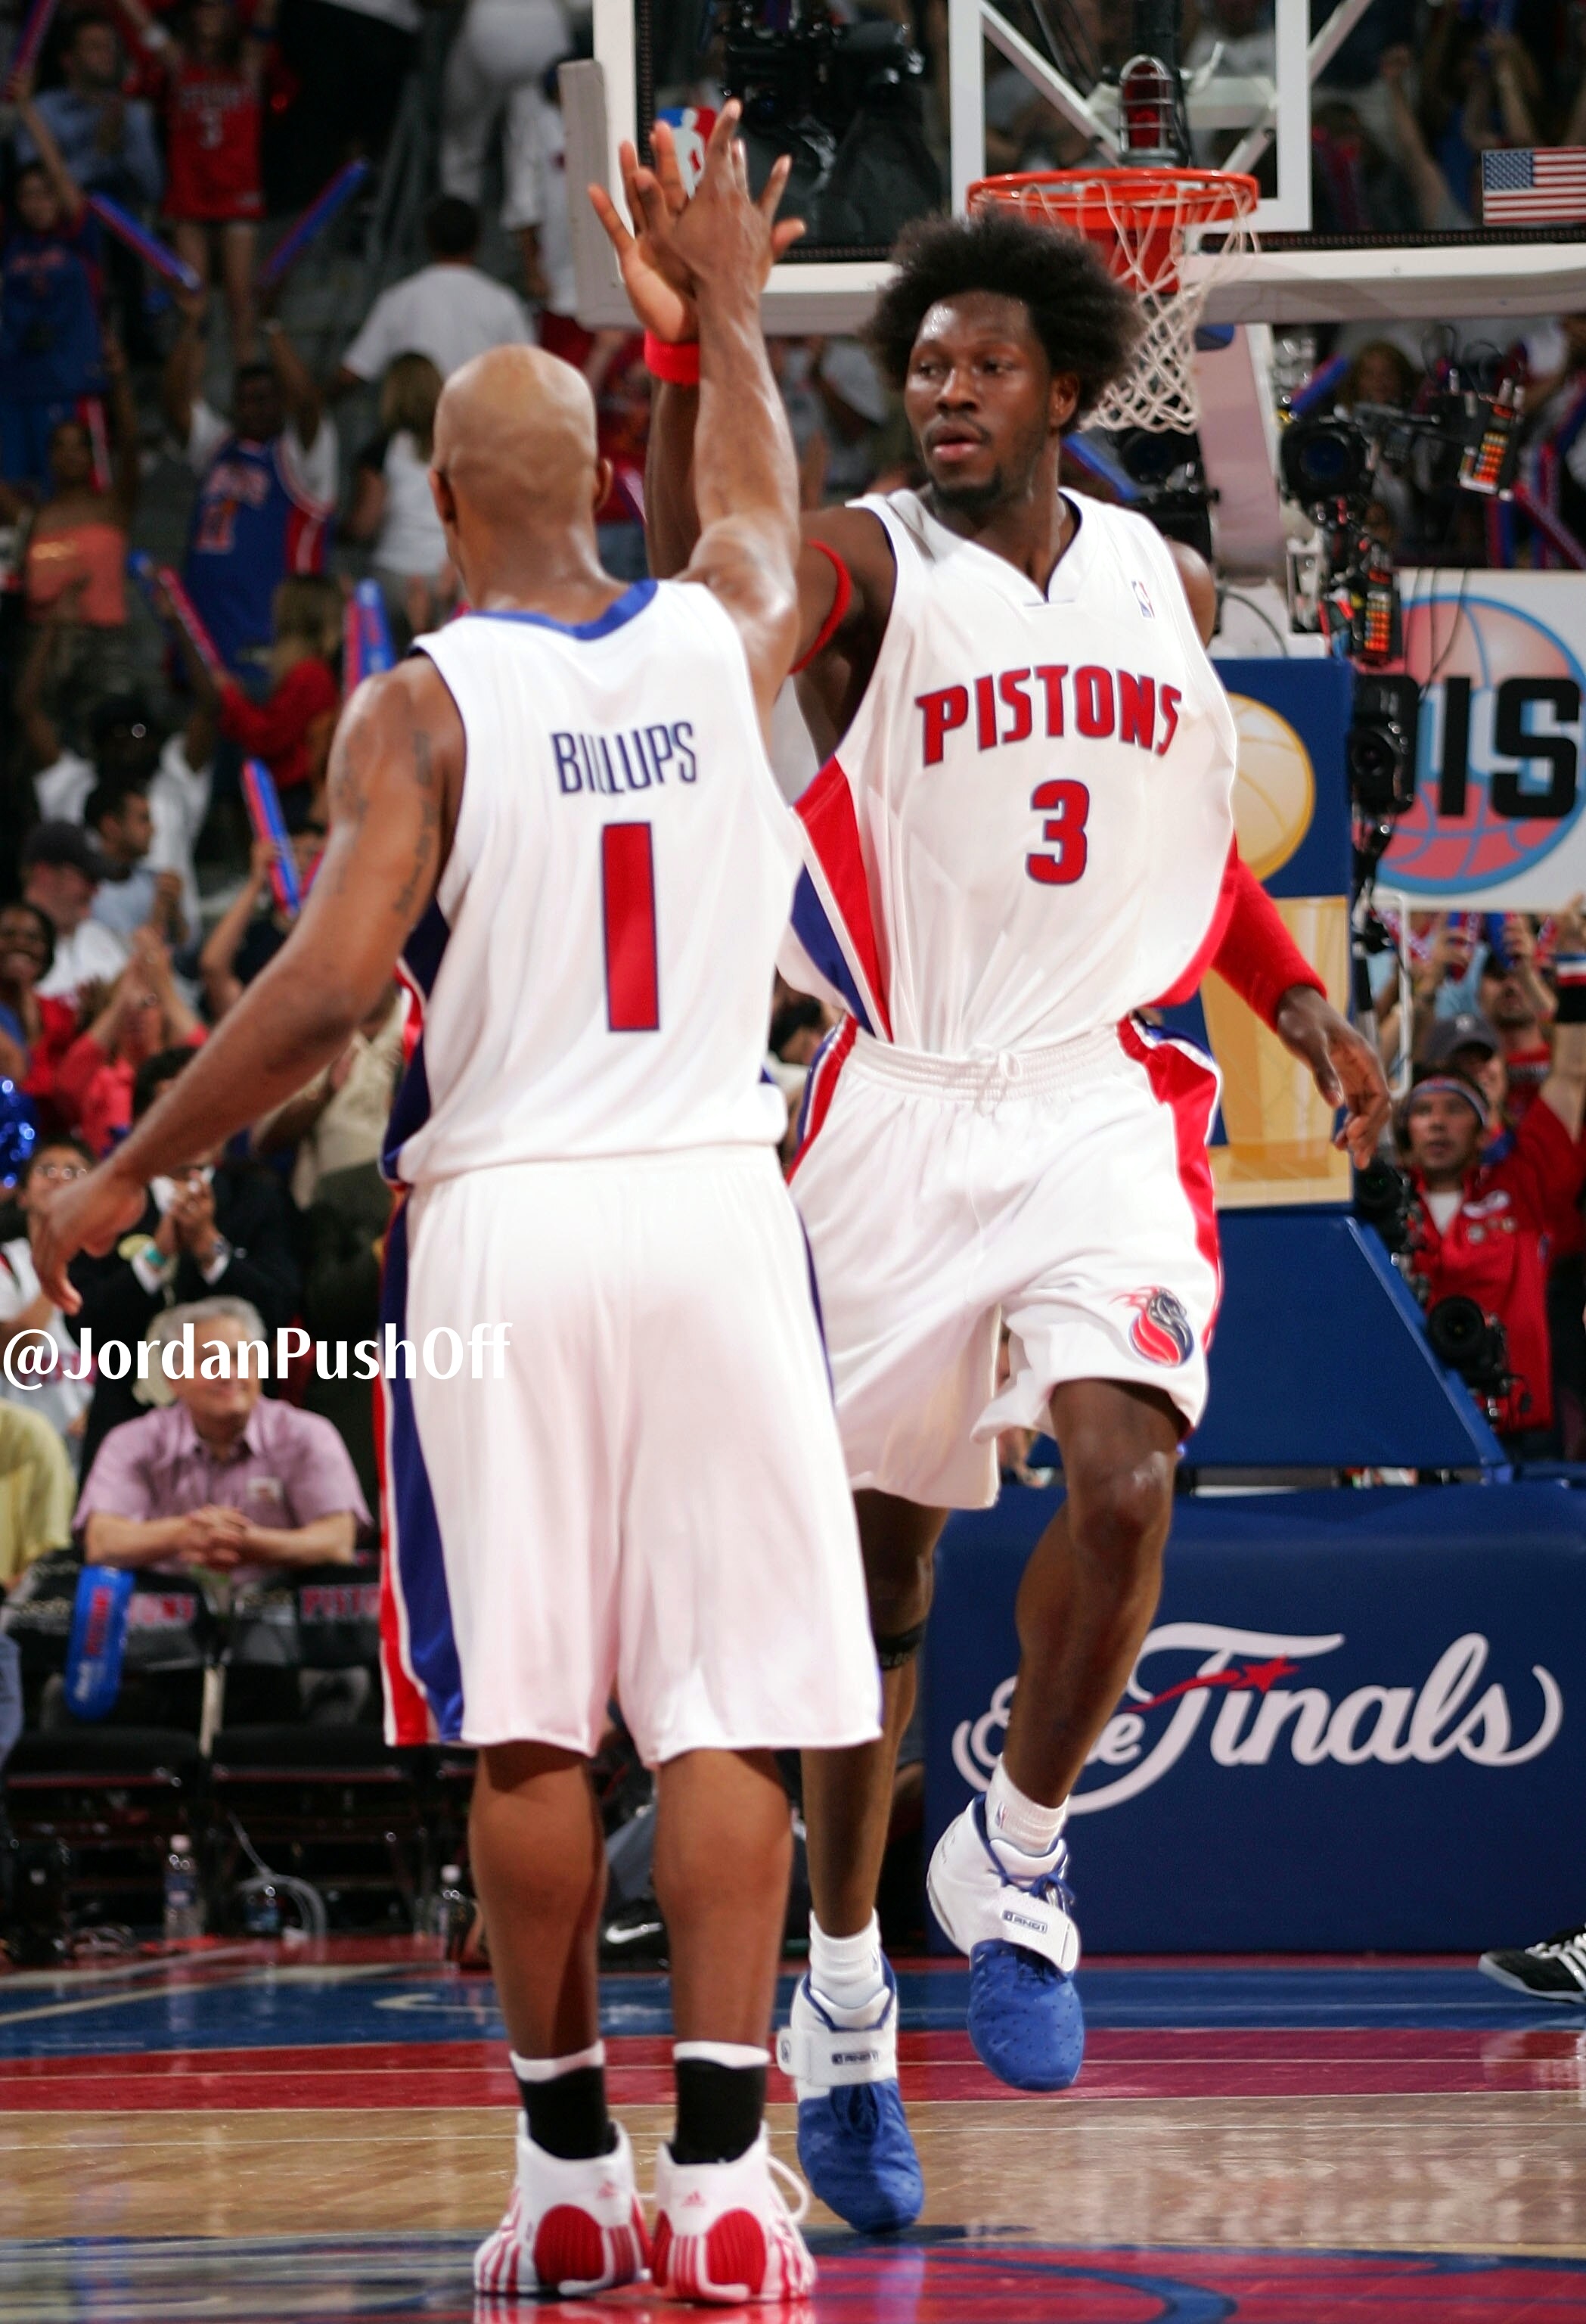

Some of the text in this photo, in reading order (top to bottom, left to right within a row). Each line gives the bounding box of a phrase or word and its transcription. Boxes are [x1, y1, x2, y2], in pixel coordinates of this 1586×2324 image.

[551, 721, 697, 794] BILLUPS
[914, 664, 1183, 768] PISTONS
[1025, 778, 1091, 886] 3
[601, 821, 660, 1032] 1
[1059, 1620, 1564, 1814] Finals
